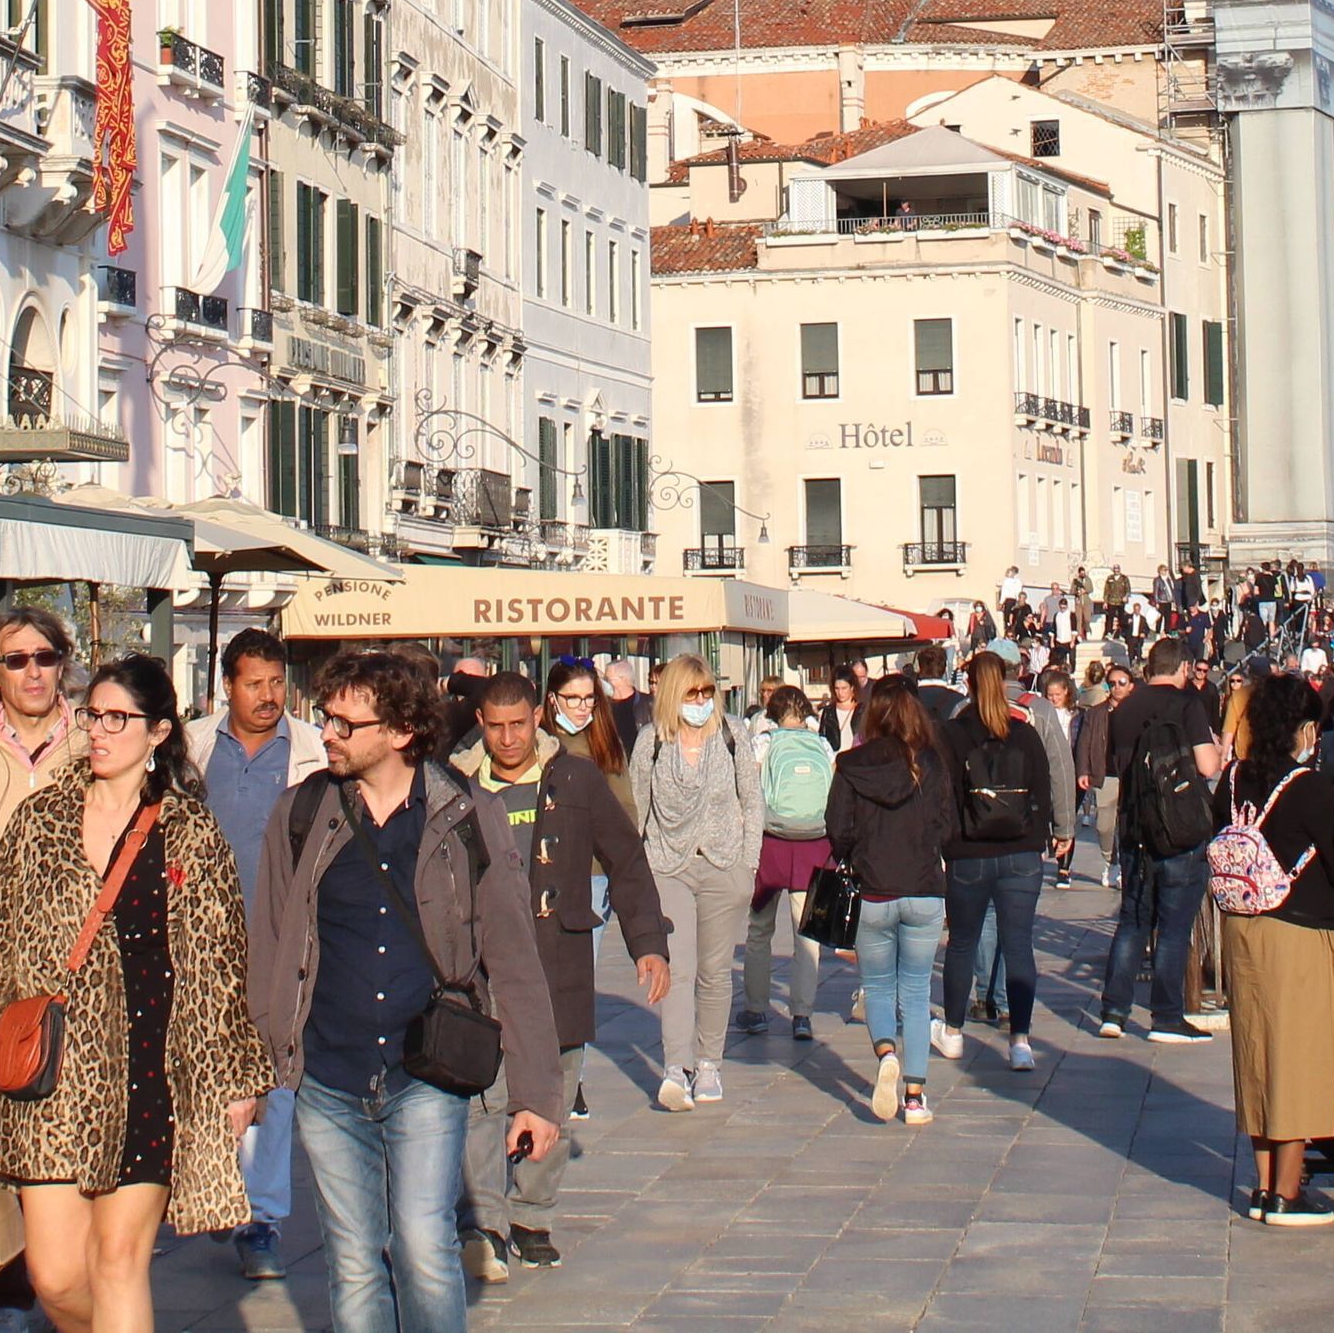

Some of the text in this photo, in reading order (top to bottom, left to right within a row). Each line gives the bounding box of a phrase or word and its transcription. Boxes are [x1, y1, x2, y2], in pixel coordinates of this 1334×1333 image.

[839, 421, 914, 448] Hôtel
[314, 581, 392, 602] PENSIONE
[314, 613, 392, 626] WILDNER
[474, 596, 684, 623] RISTORANTE
